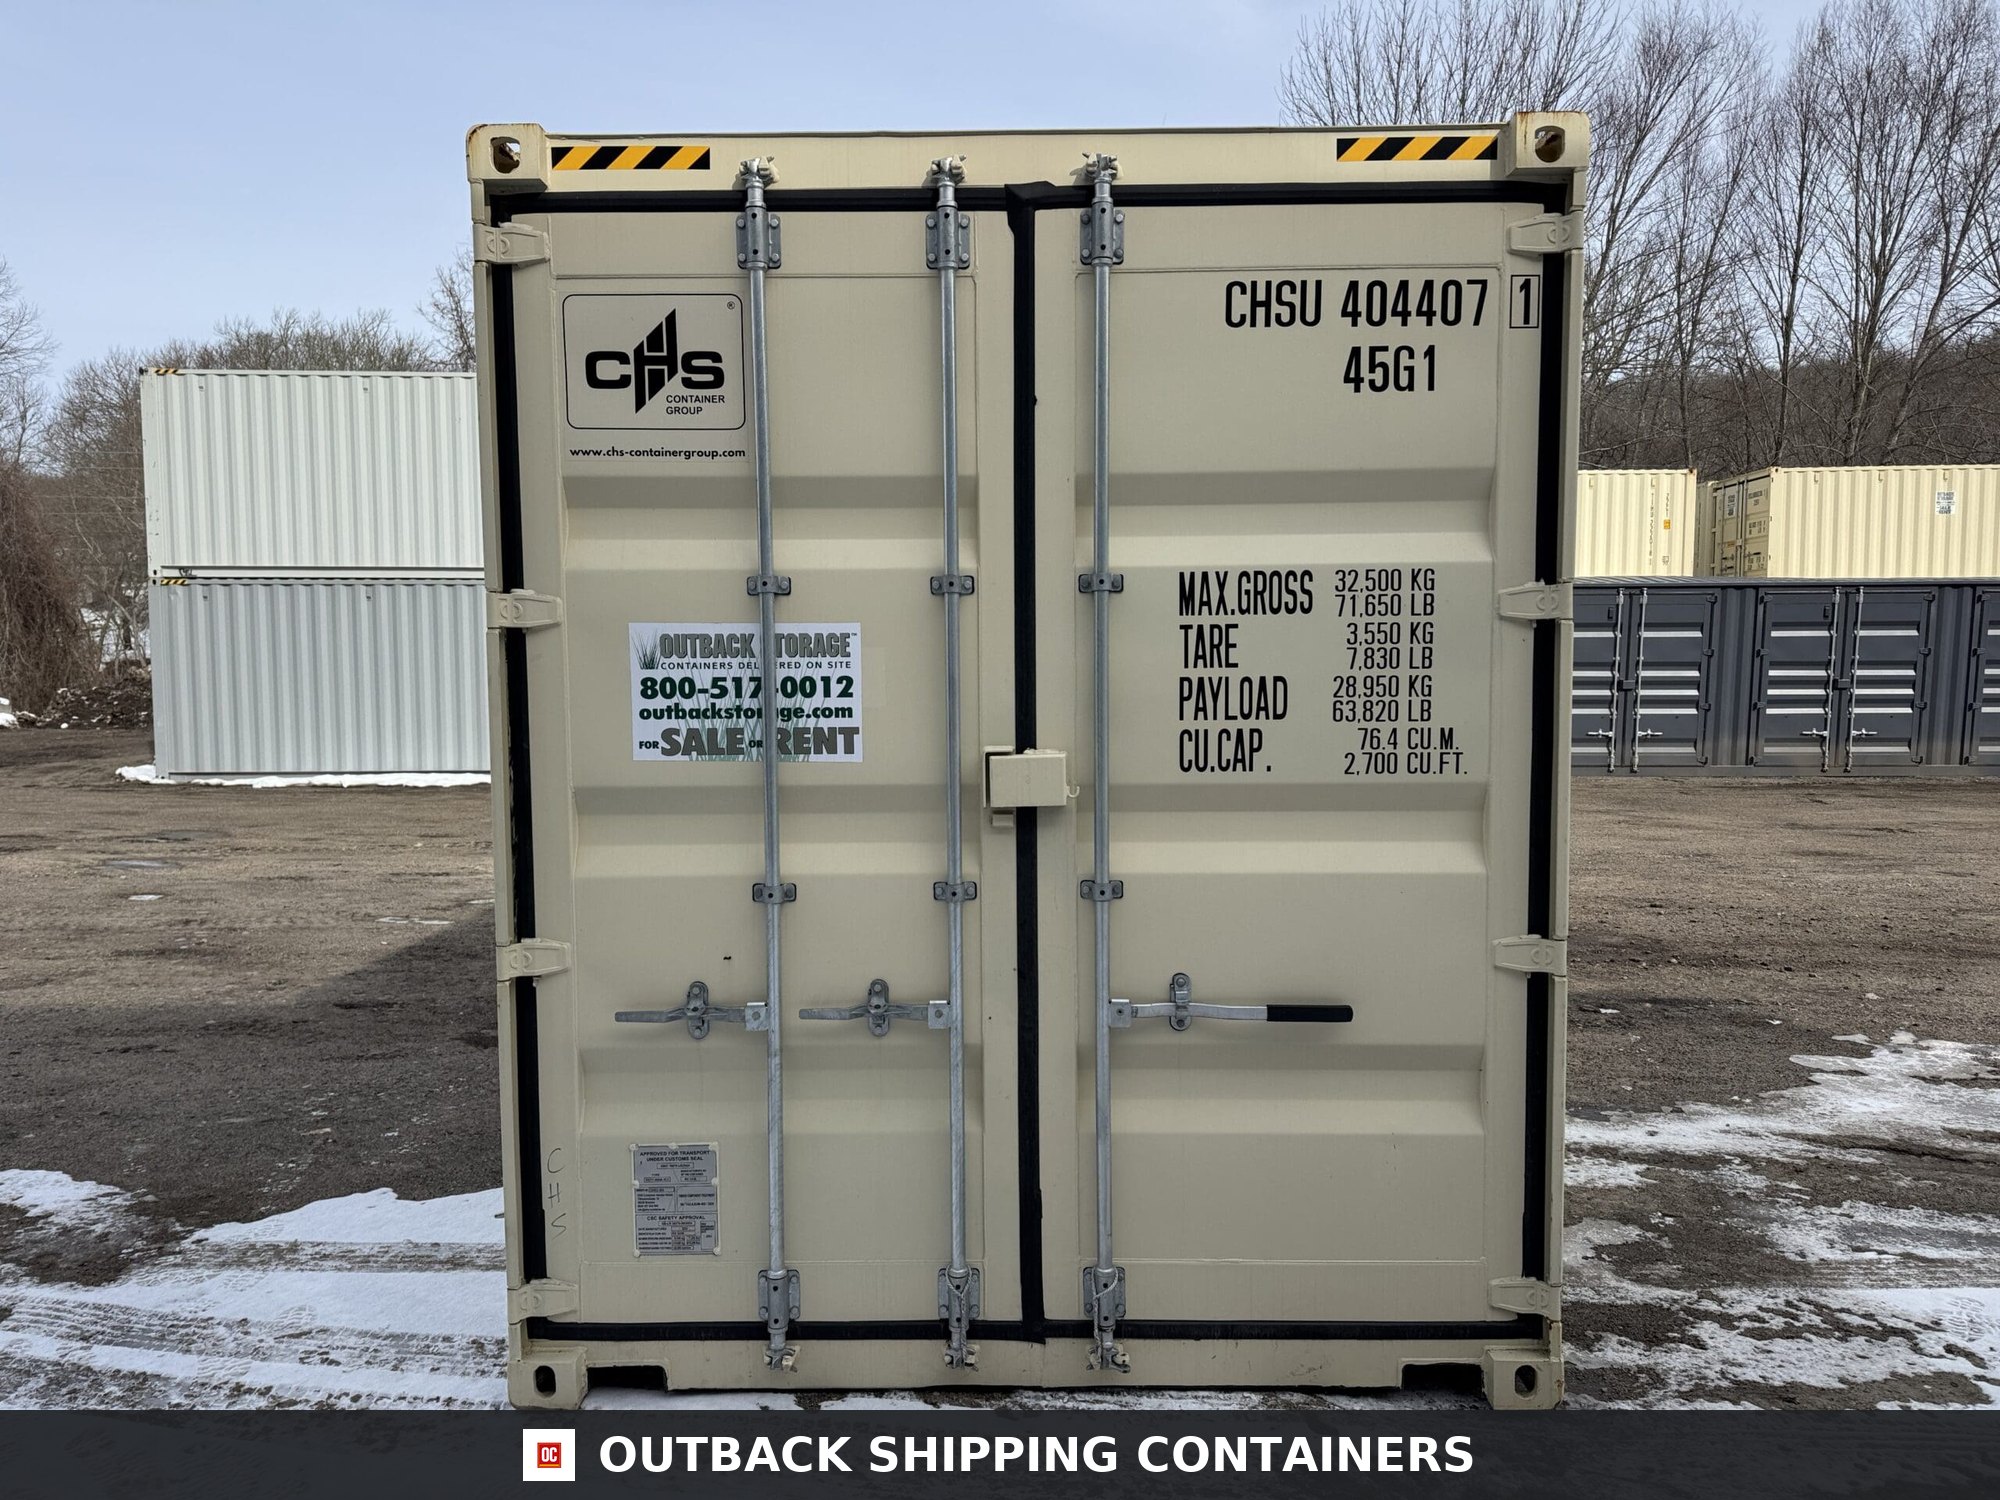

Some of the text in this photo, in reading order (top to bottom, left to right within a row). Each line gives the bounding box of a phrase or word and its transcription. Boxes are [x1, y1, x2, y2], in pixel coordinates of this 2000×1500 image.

[1224, 278, 1532, 329] CHSU 404407 1
[585, 308, 725, 414] CHS
[1343, 344, 1436, 394] 45G1
[665, 394, 726, 404] CONTAINER
[665, 406, 703, 415] GROUP
[569, 446, 746, 461] www.chs-containergroup.com
[1178, 568, 1436, 617] MAX.GROSS 32,500 KG
[1334, 593, 1435, 618] 71,650 LB
[659, 632, 851, 659] OUTBACK TORAGE
[1179, 621, 1435, 669] TARE 3,550 KG
[660, 661, 733, 671] CONTAINERS
[806, 661, 822, 669] ON
[827, 660, 852, 669] SITE
[1346, 646, 1433, 671] 7,830 LB
[639, 675, 854, 700] 800-5170012
[1178, 674, 1433, 721] PAYLOAD 28,950 KG
[1332, 699, 1432, 724] 63,820 LB
[638, 726, 860, 757] FOR SALE OR RENT
[1357, 727, 1398, 751] 76.4
[1407, 727, 1459, 751] CU.M.
[1344, 751, 1468, 776] 2,700 CU.FT.
